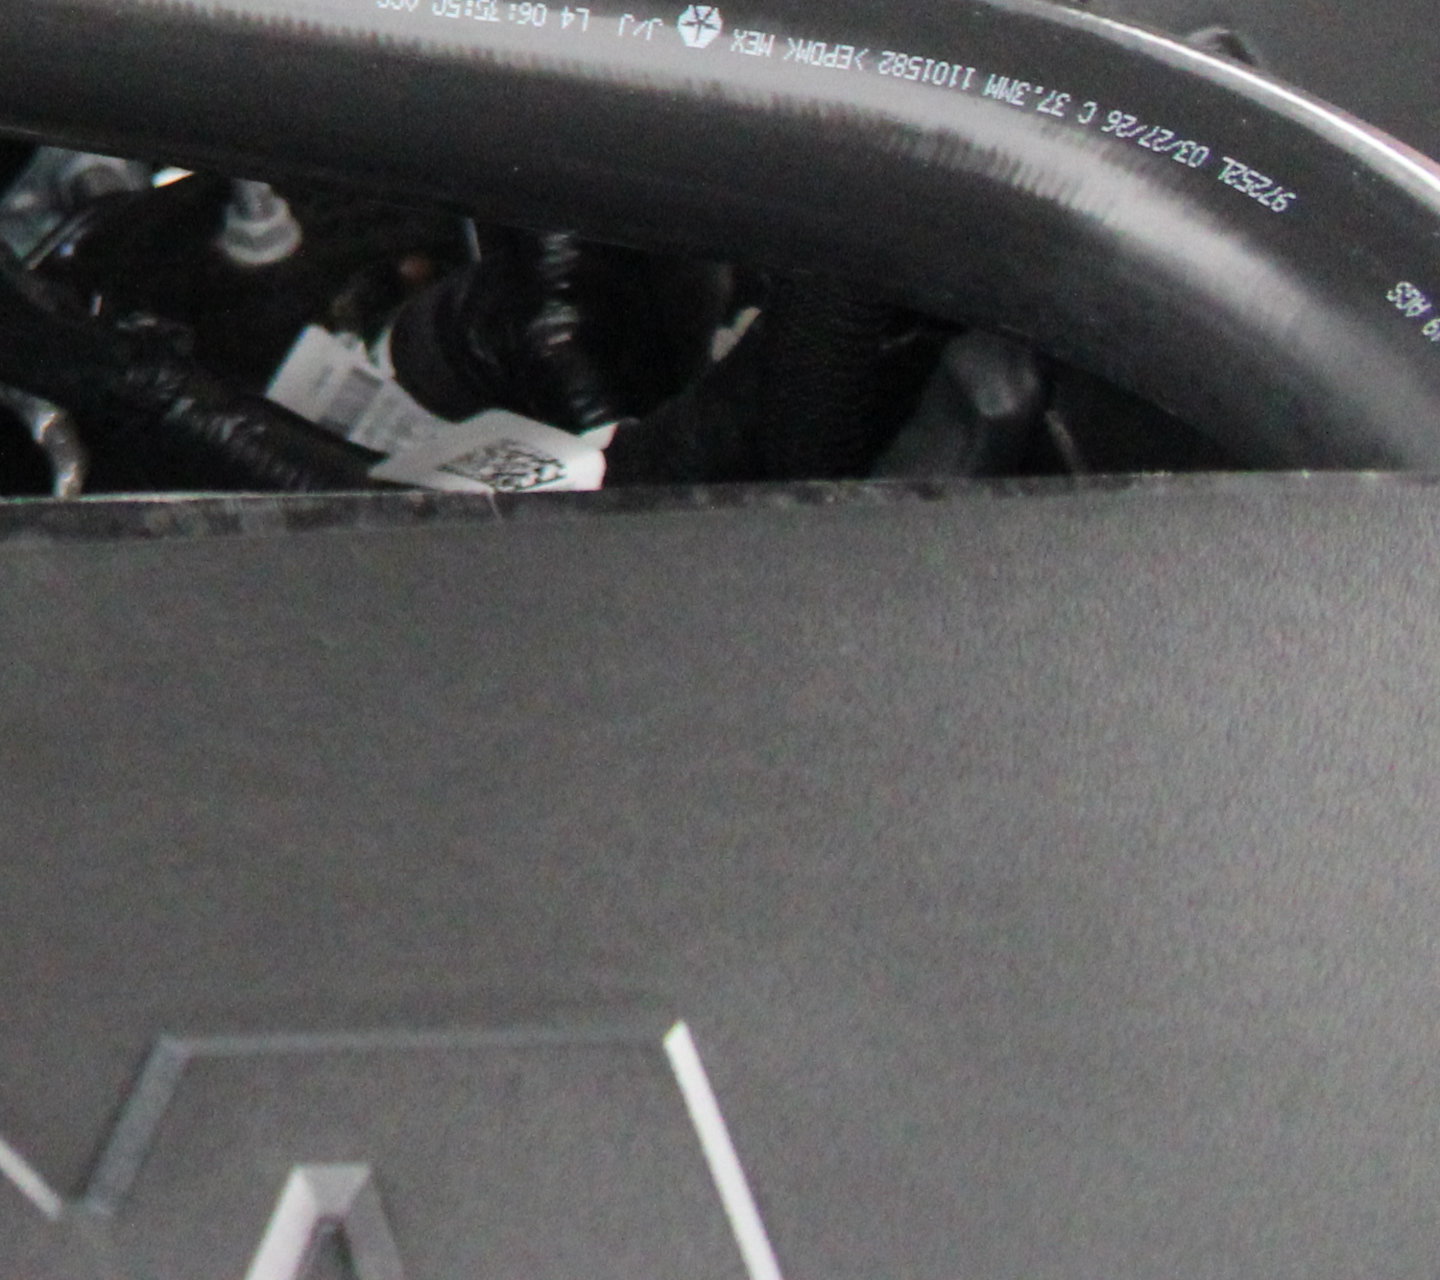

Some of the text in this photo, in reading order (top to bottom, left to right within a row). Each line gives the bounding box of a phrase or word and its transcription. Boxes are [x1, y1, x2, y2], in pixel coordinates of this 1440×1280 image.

[561, 5, 590, 33] L4
[733, 28, 775, 57] MEX
[878, 50, 975, 91] 1101582
[985, 72, 1070, 117] 37.3MM
[1078, 100, 1096, 124] C
[1107, 110, 1210, 169] 03/27/26
[1221, 156, 1298, 212] 97252L
